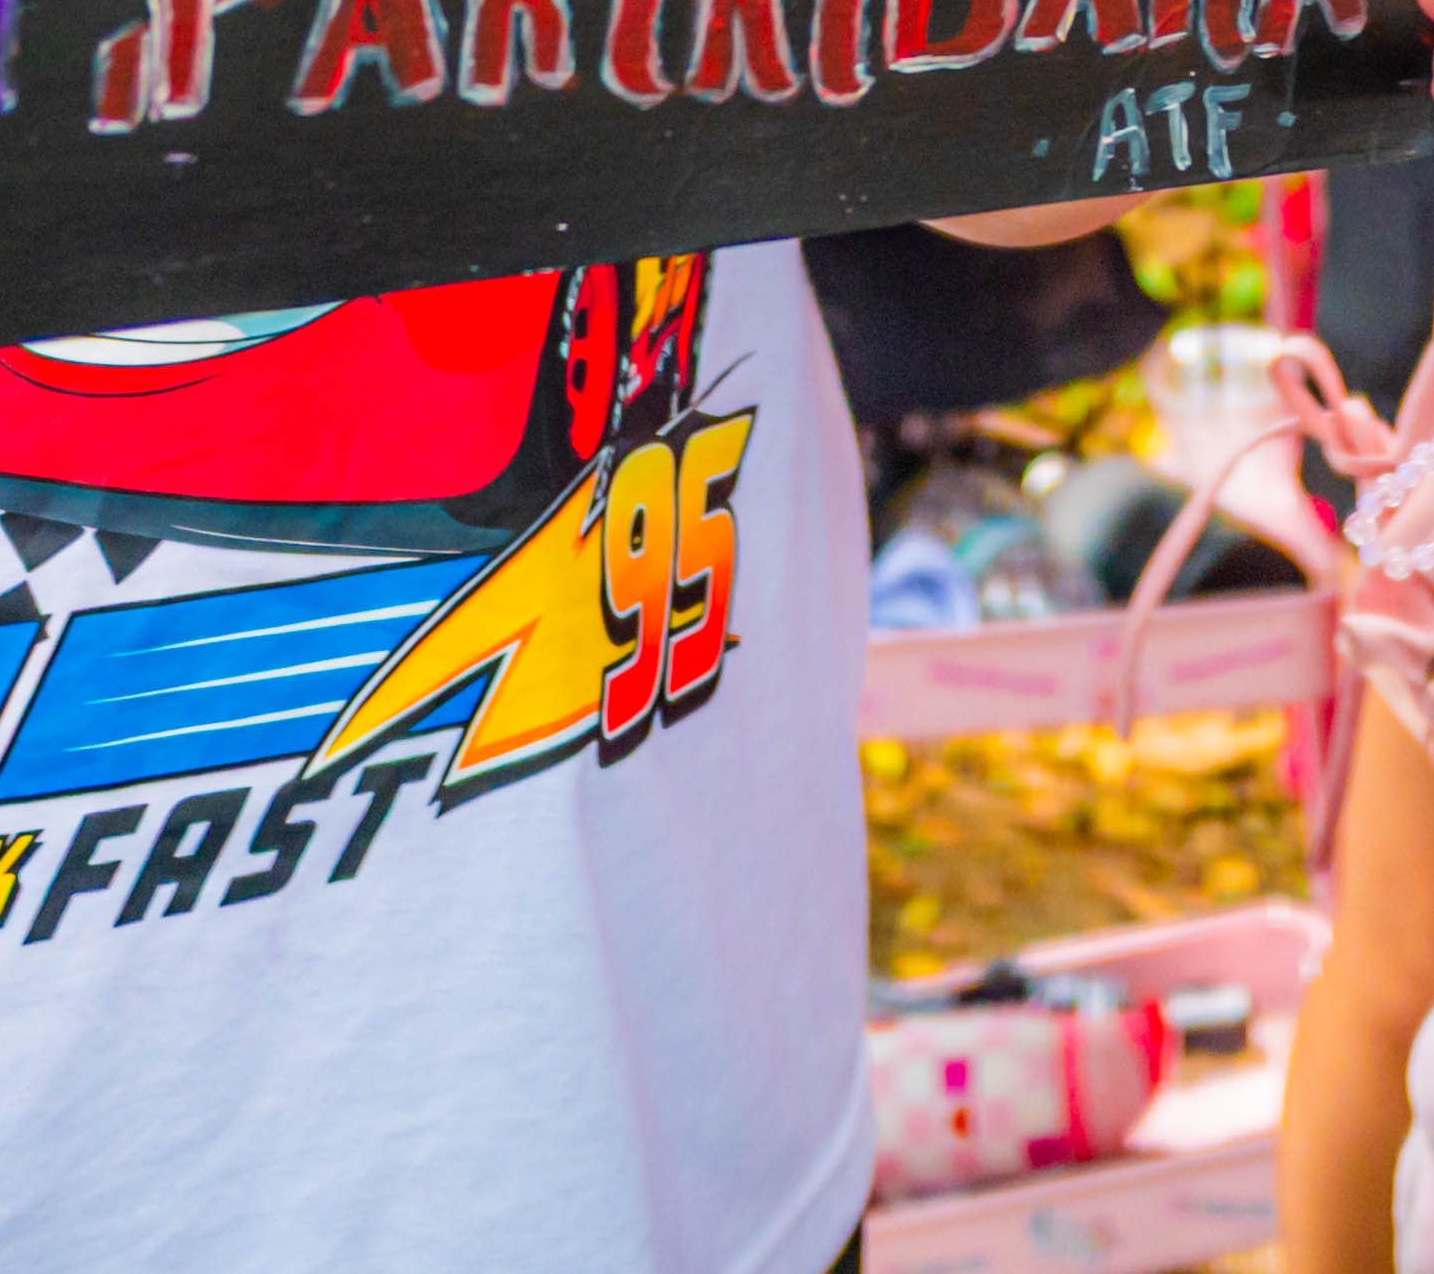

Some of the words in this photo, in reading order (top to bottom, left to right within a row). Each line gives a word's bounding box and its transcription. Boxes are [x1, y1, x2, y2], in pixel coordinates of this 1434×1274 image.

[1090, 80, 1254, 193] ATF
[600, 405, 758, 769] 95
[23, 752, 445, 945] FAST
